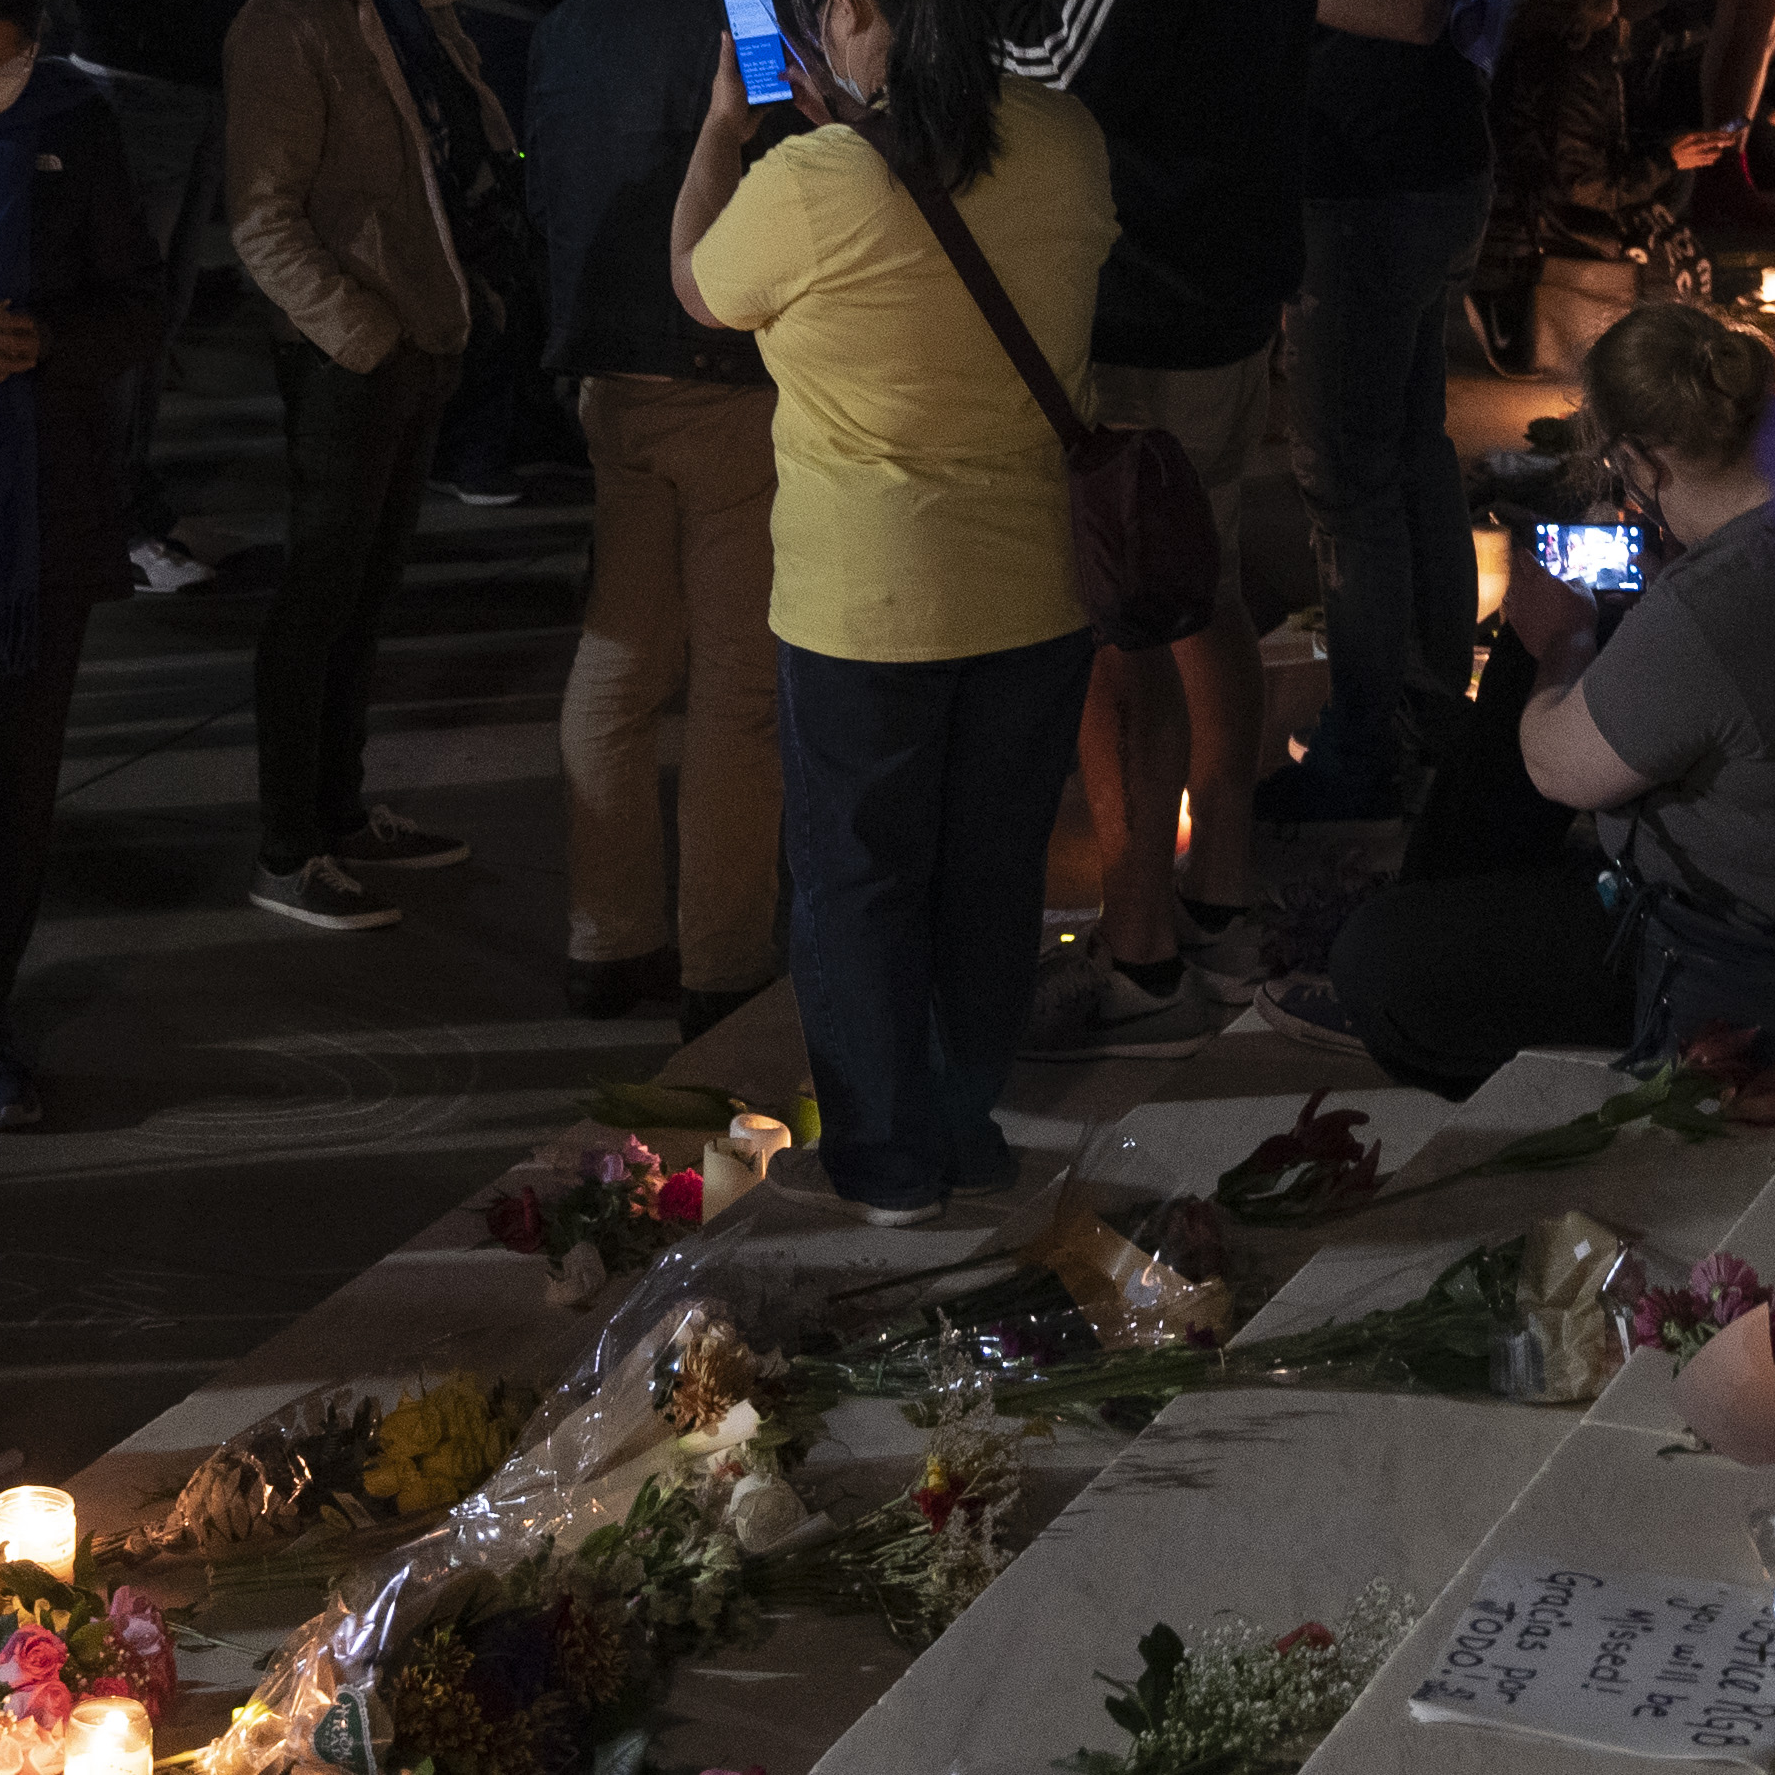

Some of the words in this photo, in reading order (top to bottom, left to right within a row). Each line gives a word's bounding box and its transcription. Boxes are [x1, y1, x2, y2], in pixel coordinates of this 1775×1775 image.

[1515, 1570, 1604, 1651] Gracias
[1492, 1658, 1537, 1704] por
[1655, 1643, 1705, 1683] will
[1632, 1692, 1689, 1718] be
